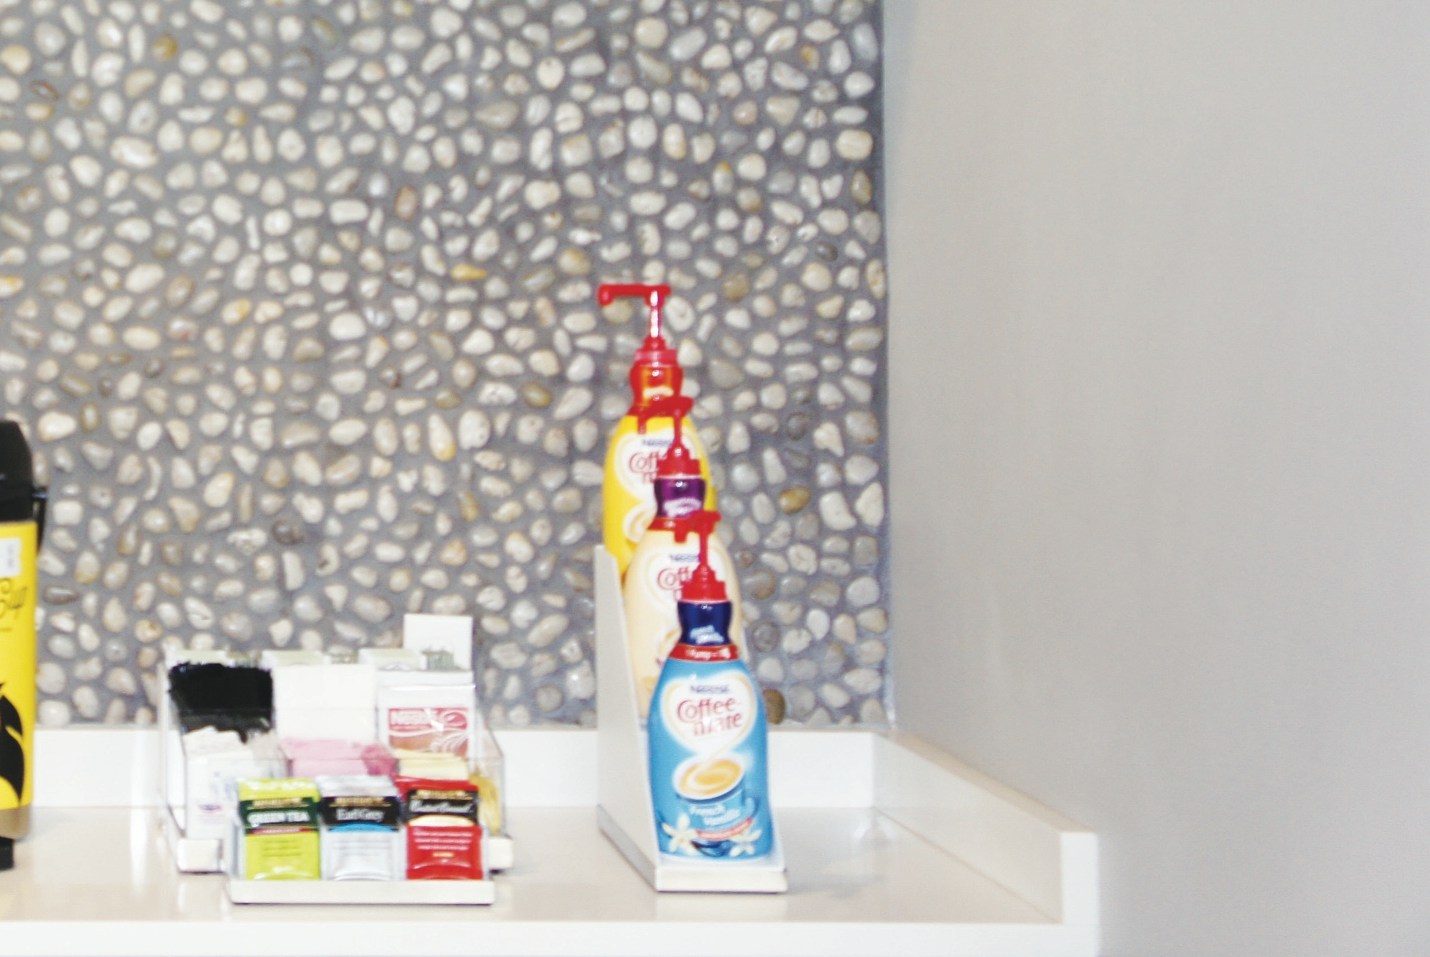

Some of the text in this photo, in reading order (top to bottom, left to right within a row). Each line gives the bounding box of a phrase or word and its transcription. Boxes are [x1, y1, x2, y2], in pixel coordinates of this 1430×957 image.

[247, 811, 310, 824] GREEN TEA
[336, 808, 384, 823] Earl Grey
